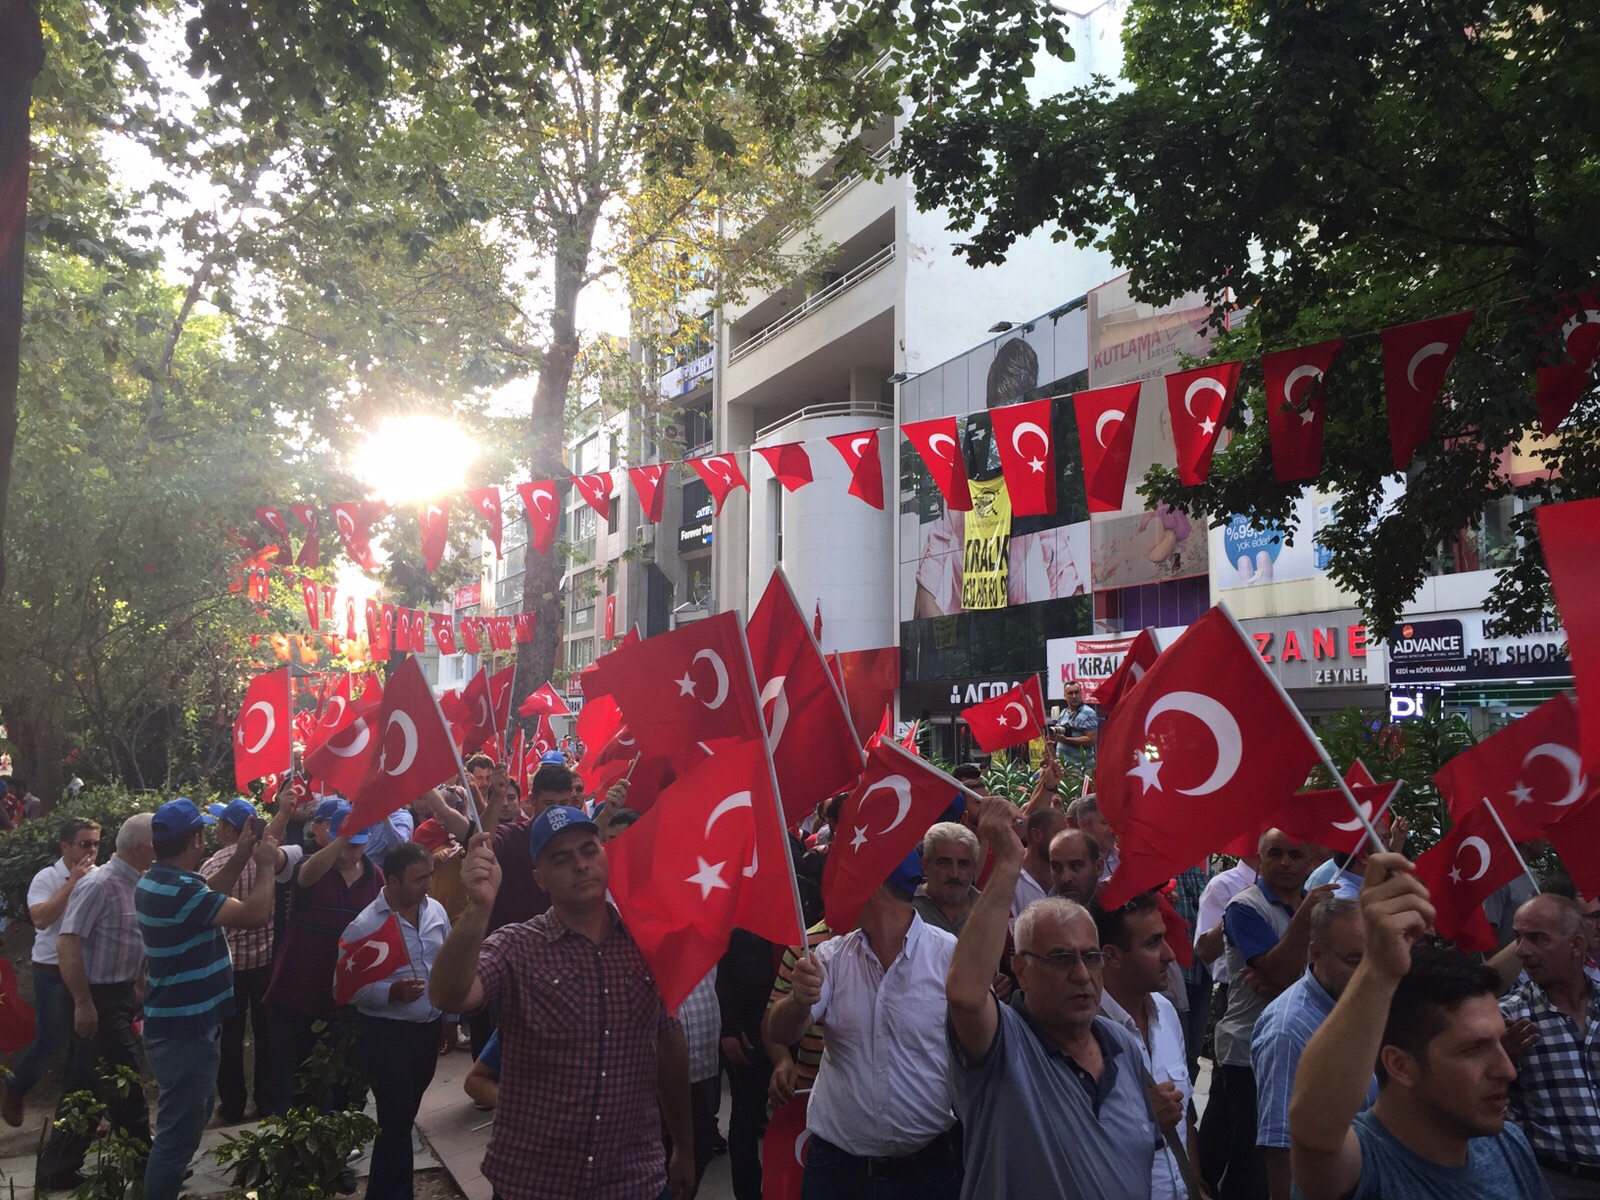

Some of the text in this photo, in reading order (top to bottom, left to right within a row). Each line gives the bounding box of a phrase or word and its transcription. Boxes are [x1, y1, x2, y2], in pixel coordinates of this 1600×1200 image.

[1094, 331, 1161, 369] KUTLAMA
[680, 527, 702, 541] Forever
[1393, 636, 1460, 654] ADVANCE
[1471, 643, 1559, 666] PET SHOP
